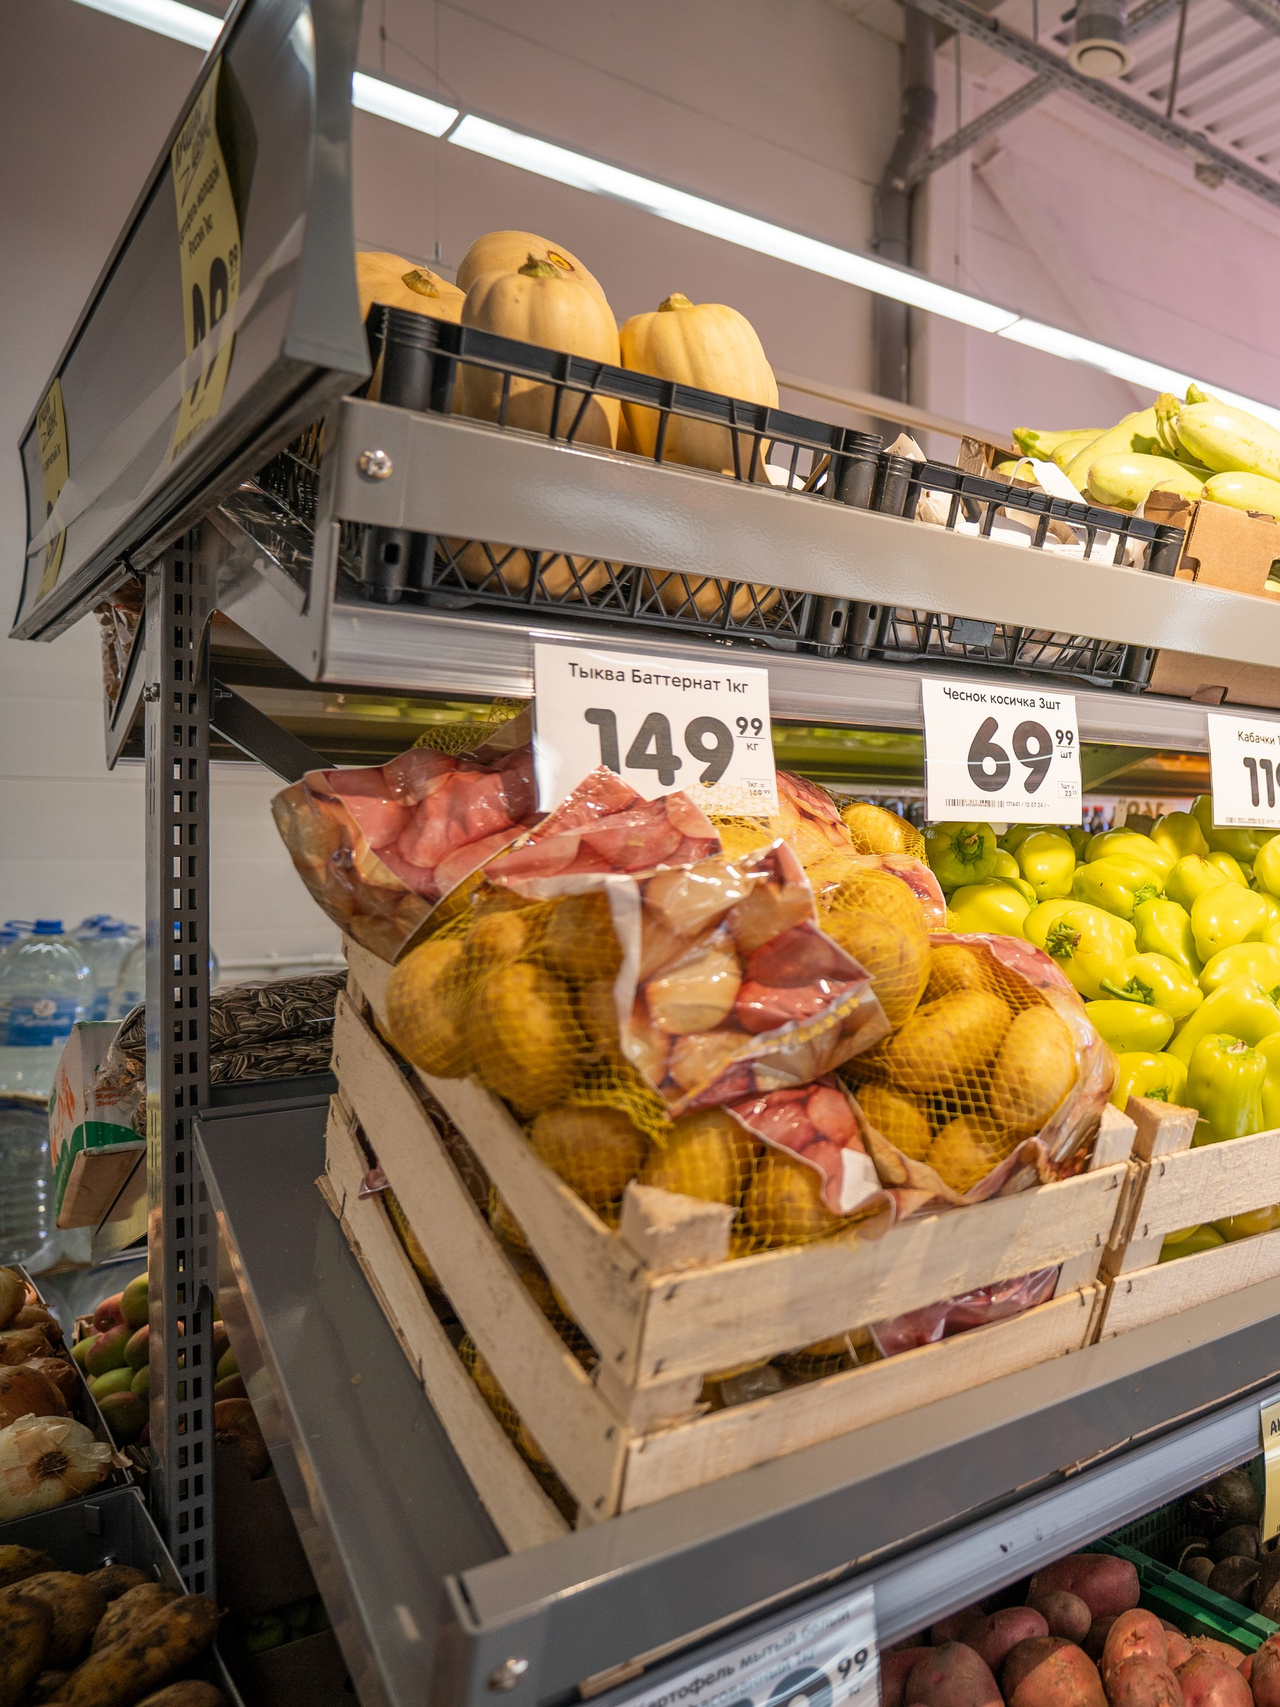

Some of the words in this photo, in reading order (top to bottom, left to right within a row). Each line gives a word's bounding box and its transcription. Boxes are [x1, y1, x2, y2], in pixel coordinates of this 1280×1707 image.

[568, 662, 625, 682] Тыква
[632, 669, 721, 692] Баттернат
[726, 678, 749, 694] 1кг
[943, 687, 987, 702] Чеснок
[990, 694, 1036, 708] косичка
[1039, 697, 1061, 711] 3шт
[736, 716, 763, 736] 99
[1055, 729, 1074, 746] 99
[1237, 730, 1275, 746] Кабачки
[585, 707, 734, 788] 149
[747, 742, 759, 752] кг
[967, 716, 1053, 794] 69
[1060, 751, 1073, 759] шт
[740, 1631, 797, 1670] мытый
[801, 1609, 850, 1640] белый
[837, 1647, 869, 1679] 99
